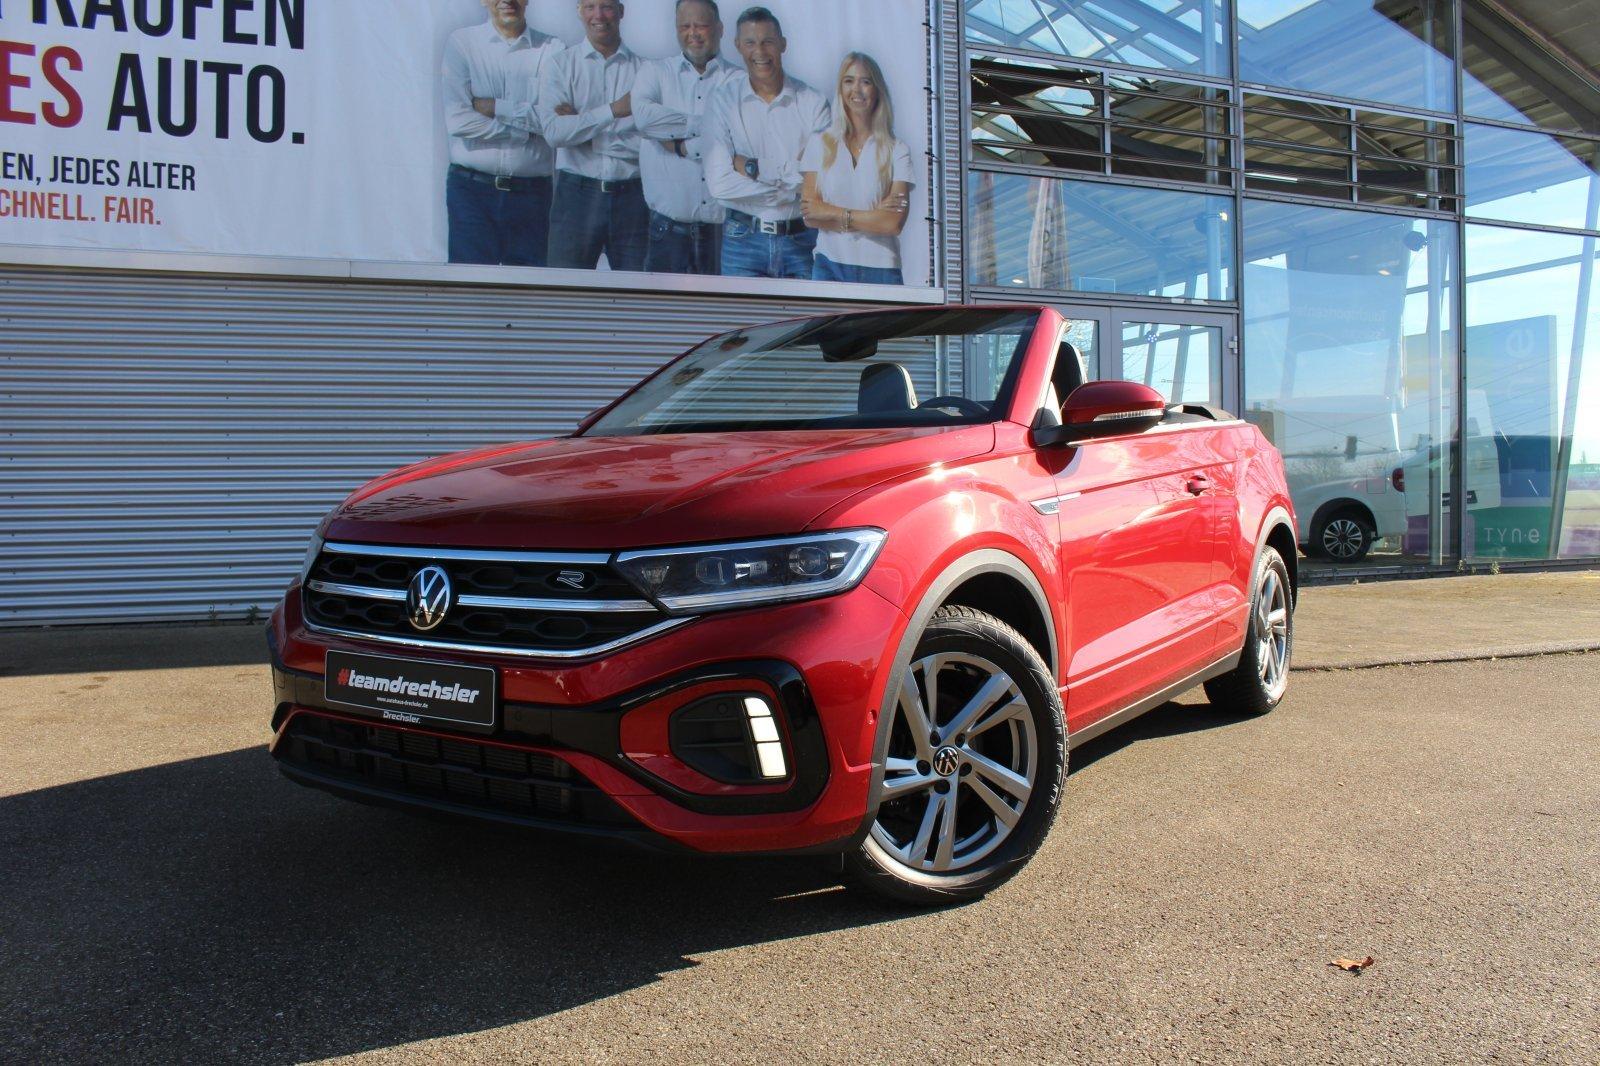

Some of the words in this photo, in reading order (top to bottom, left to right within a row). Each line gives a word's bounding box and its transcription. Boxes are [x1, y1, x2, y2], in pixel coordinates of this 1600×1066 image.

[0, 40, 83, 128] ES
[107, 53, 304, 144] AUTO.
[50, 155, 120, 187] JEDES
[127, 161, 195, 191] ALTER
[104, 196, 161, 225] FAIR.
[337, 667, 480, 704] #teamdrechsler
[382, 710, 421, 724] Drechsler.
